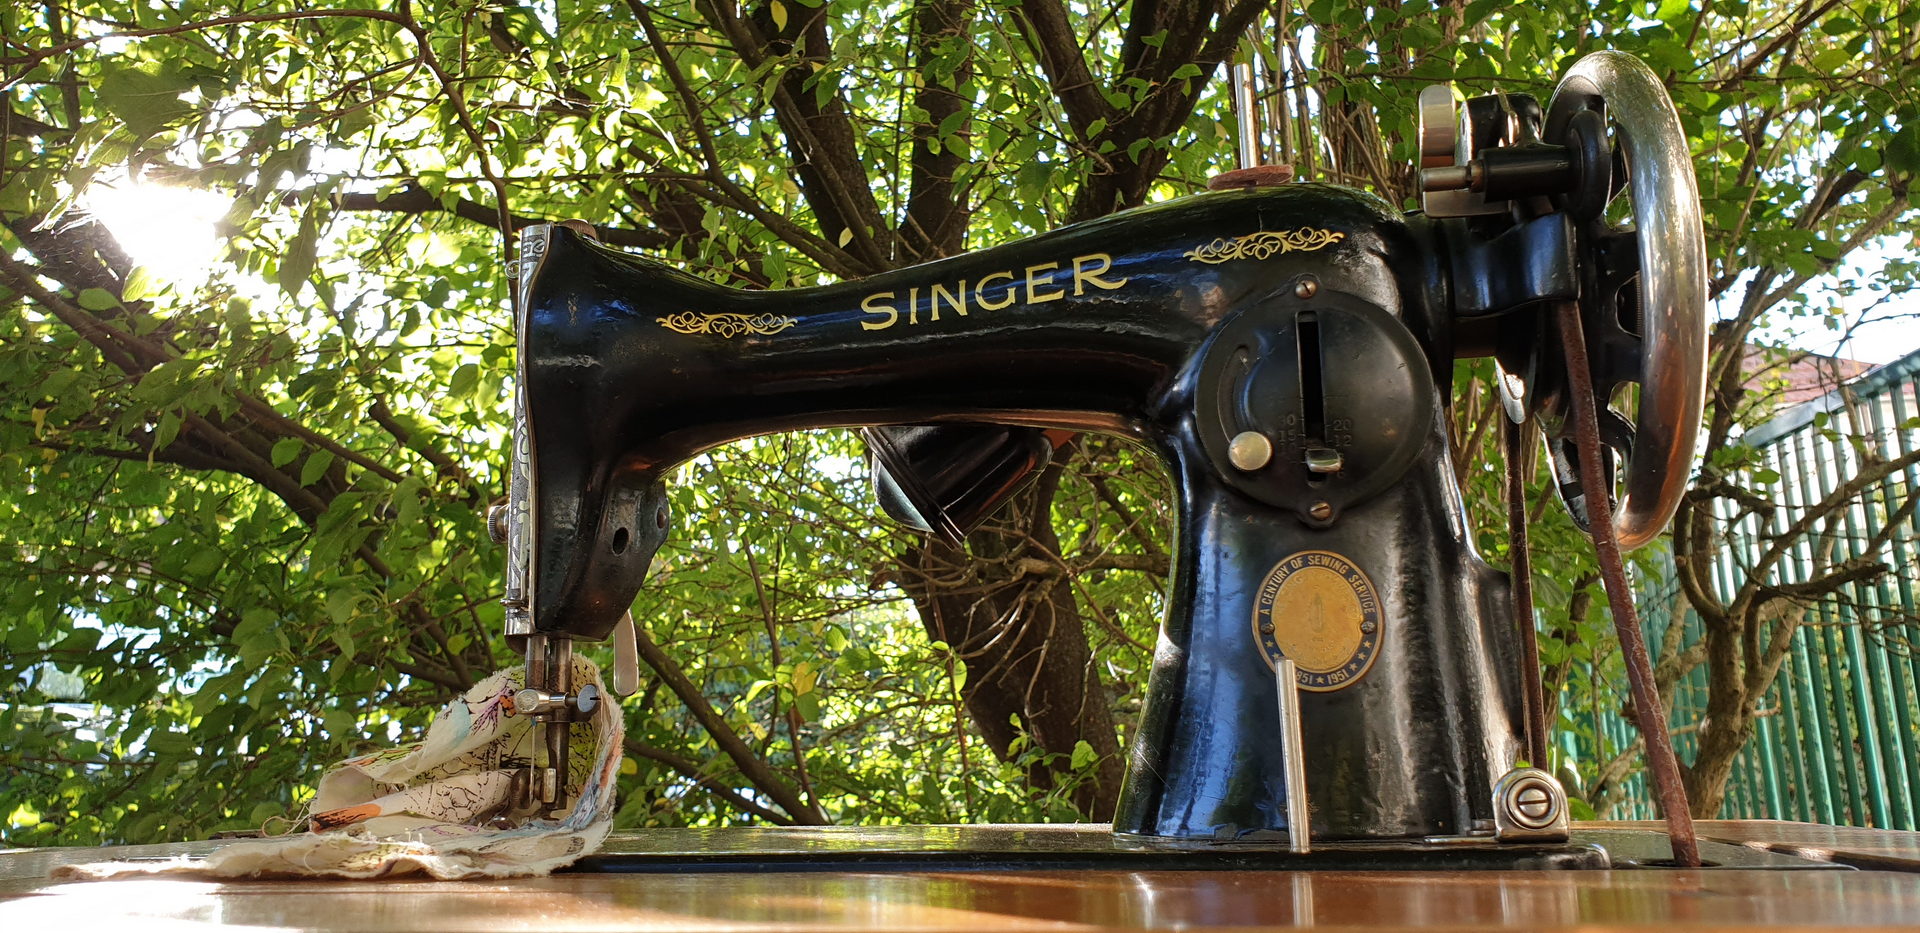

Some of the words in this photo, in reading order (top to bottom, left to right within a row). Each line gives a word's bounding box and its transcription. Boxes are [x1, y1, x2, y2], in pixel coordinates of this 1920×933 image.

[860, 253, 1128, 330] SINGER
[1262, 564, 1291, 605] CENTURY
[1291, 557, 1304, 569] OF
[1308, 555, 1349, 574] SEWING
[1349, 574, 1376, 614] SERVICE
[1296, 673, 1313, 685] 851
[1327, 670, 1350, 685] 1951
